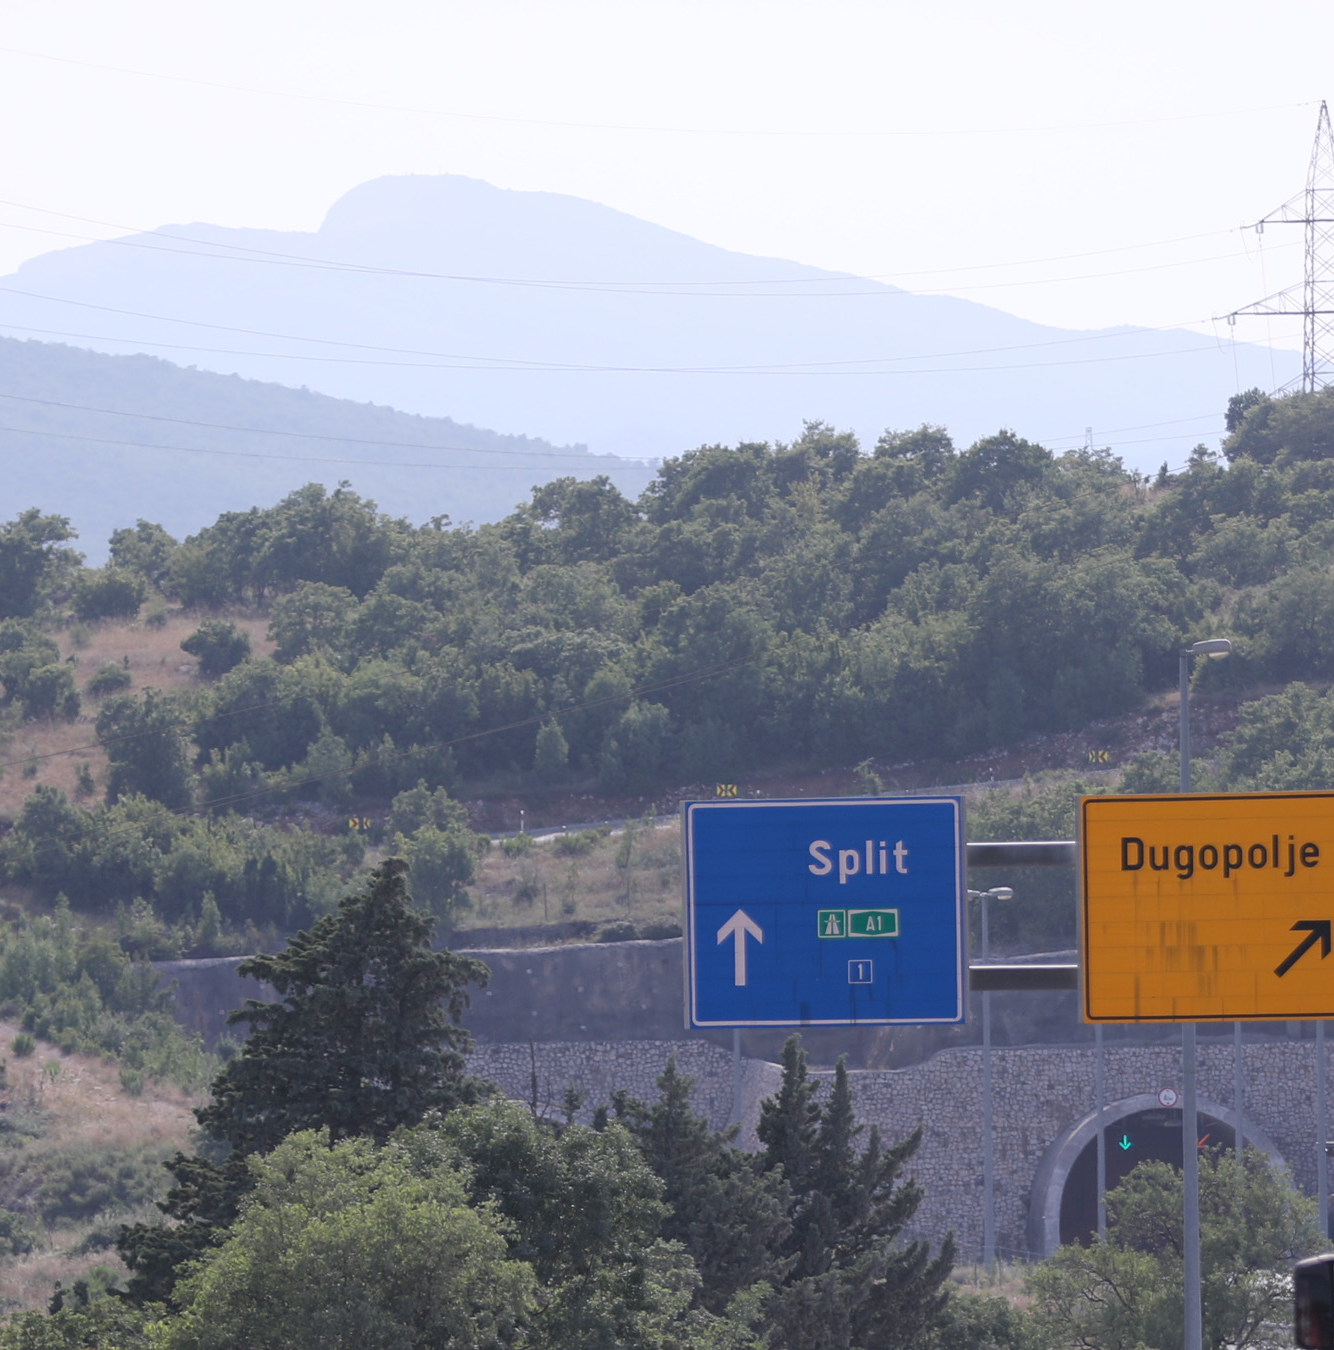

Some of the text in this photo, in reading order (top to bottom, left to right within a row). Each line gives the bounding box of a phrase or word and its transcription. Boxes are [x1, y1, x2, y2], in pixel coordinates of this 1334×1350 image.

[808, 840, 908, 884] Split
[1121, 834, 1320, 880] Dugopolje
[866, 915, 882, 931] A1
[857, 963, 863, 980] 1
